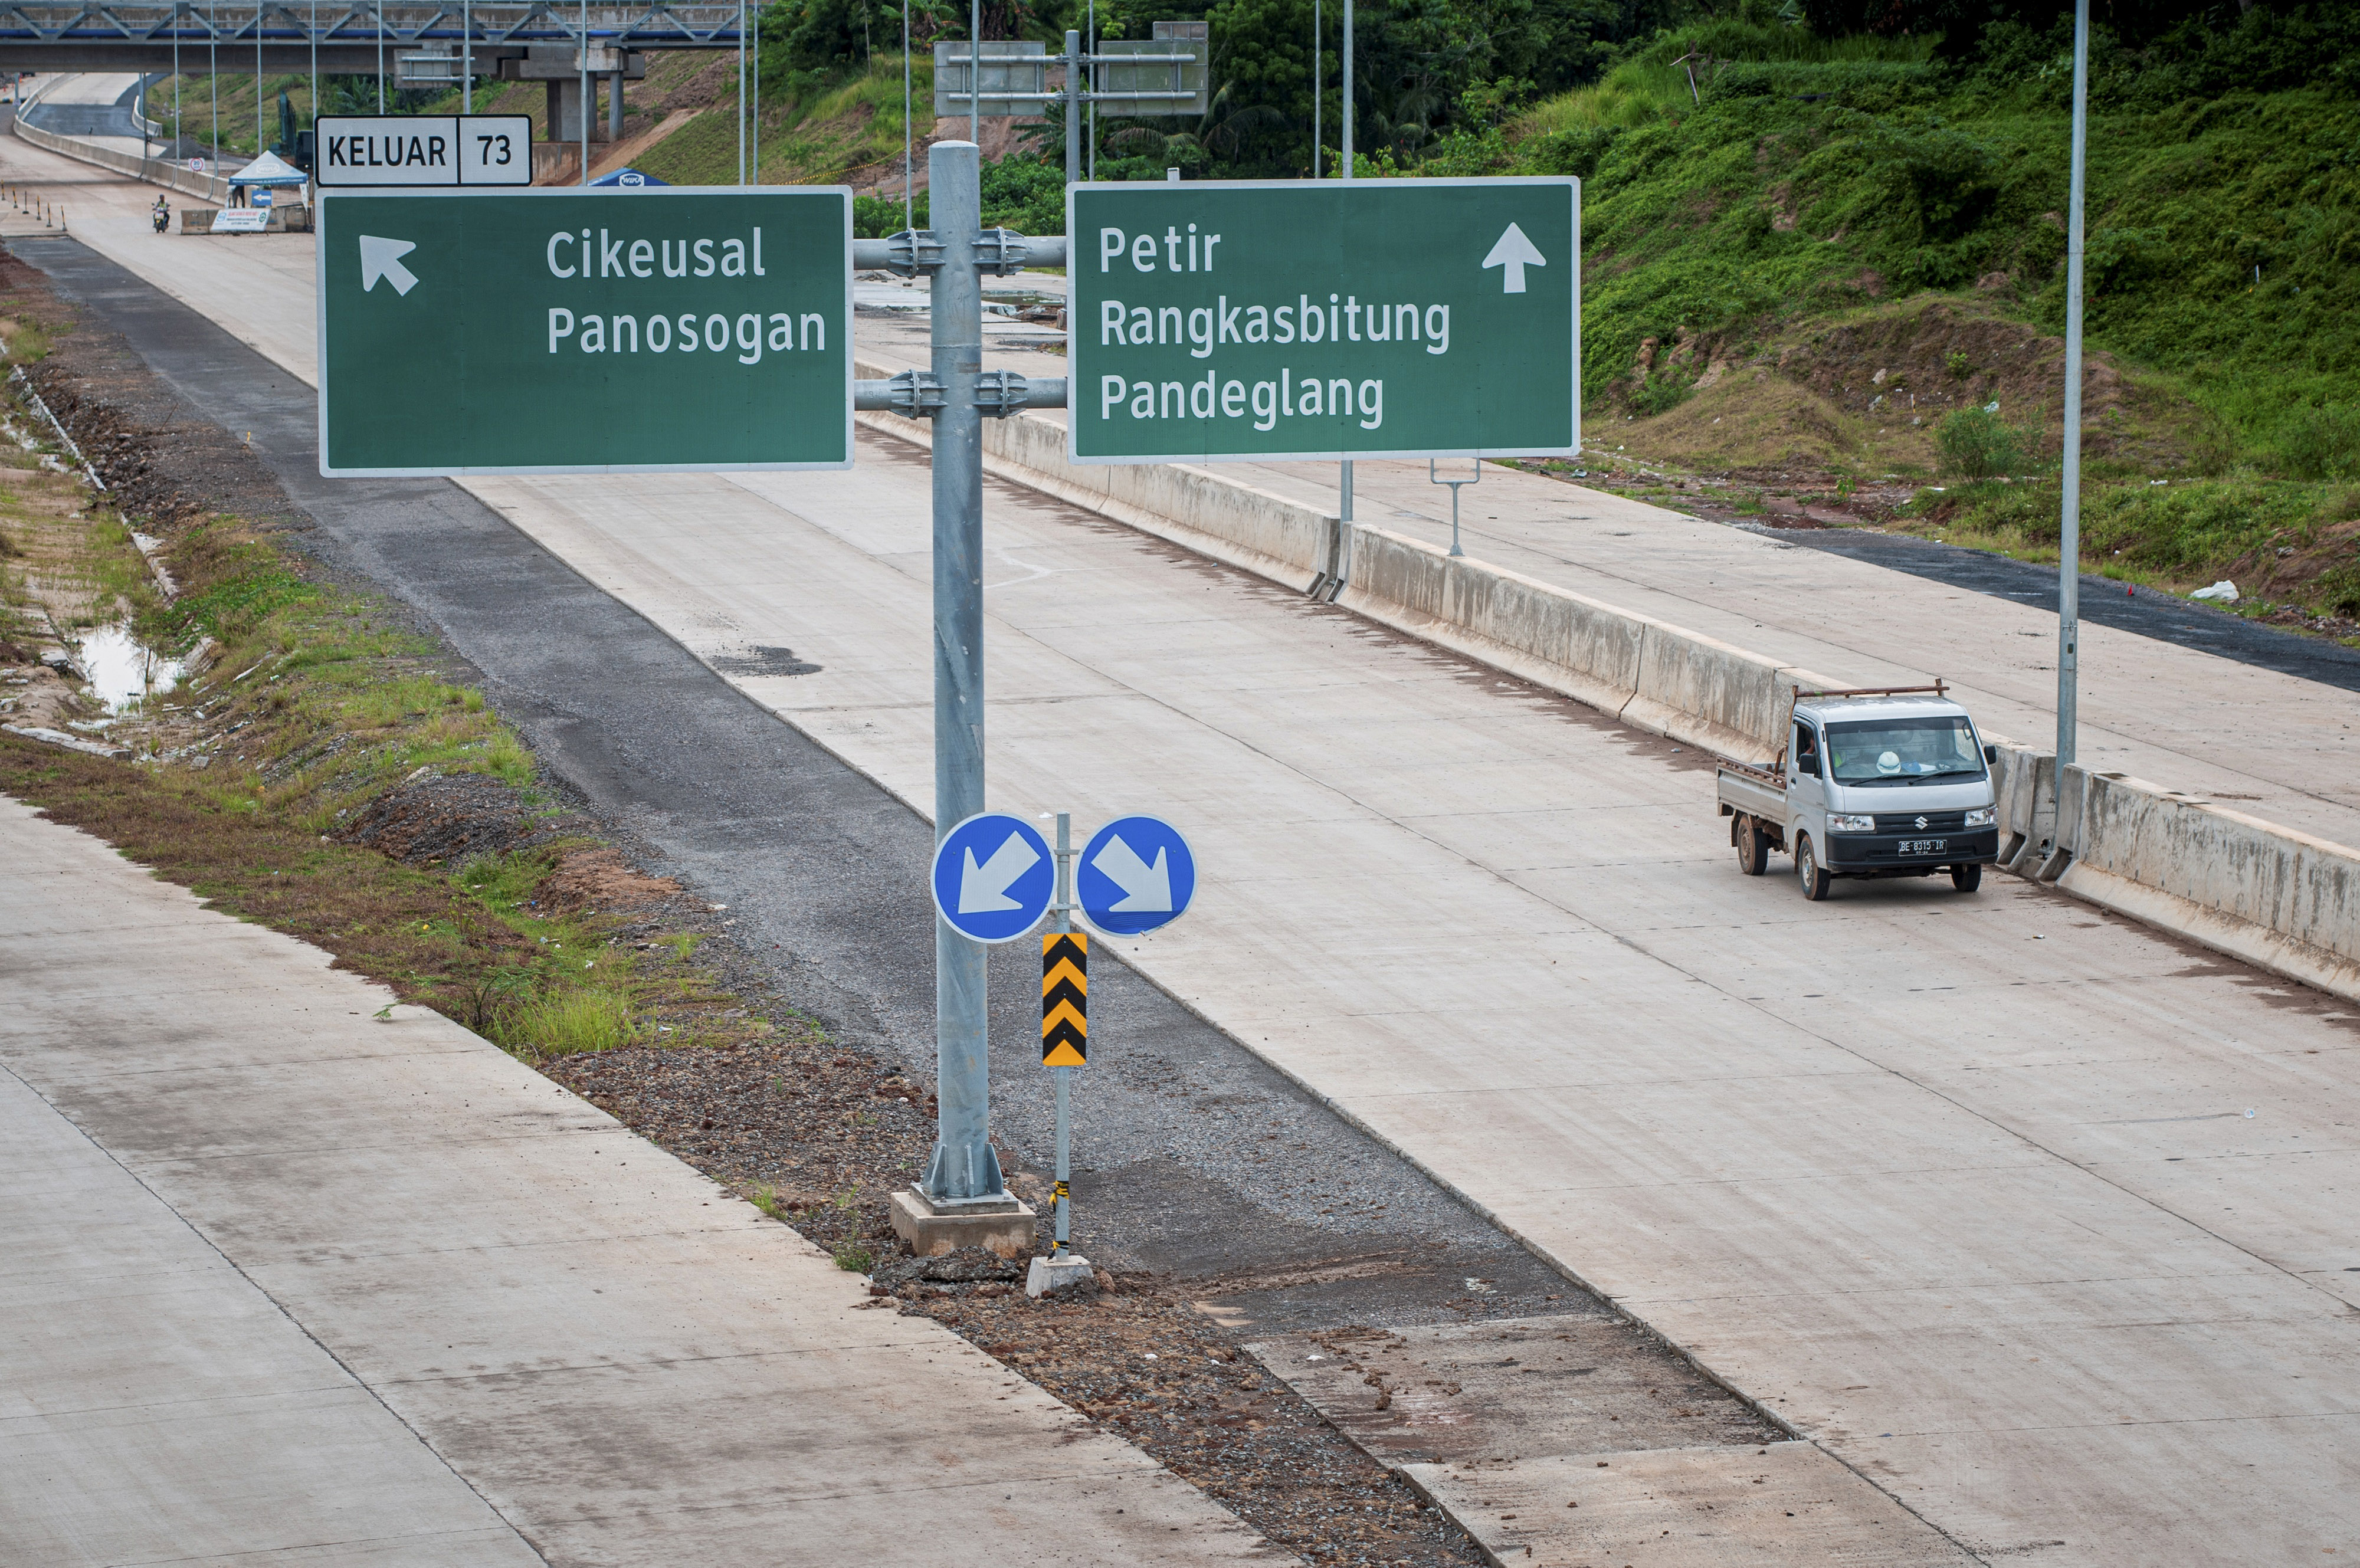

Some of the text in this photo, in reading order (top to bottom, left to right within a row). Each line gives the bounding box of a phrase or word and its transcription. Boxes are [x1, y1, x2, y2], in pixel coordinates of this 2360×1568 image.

[329, 135, 446, 166] KELUAR
[477, 135, 511, 165] 73
[548, 227, 765, 278] Cikeusal
[1101, 223, 1221, 272] Petir
[549, 308, 824, 365] Panosogan
[1102, 293, 1449, 358] Rangkasbitung
[1102, 368, 1382, 431] Pandeglang
[1901, 841, 1944, 851] BE 8315 IR
